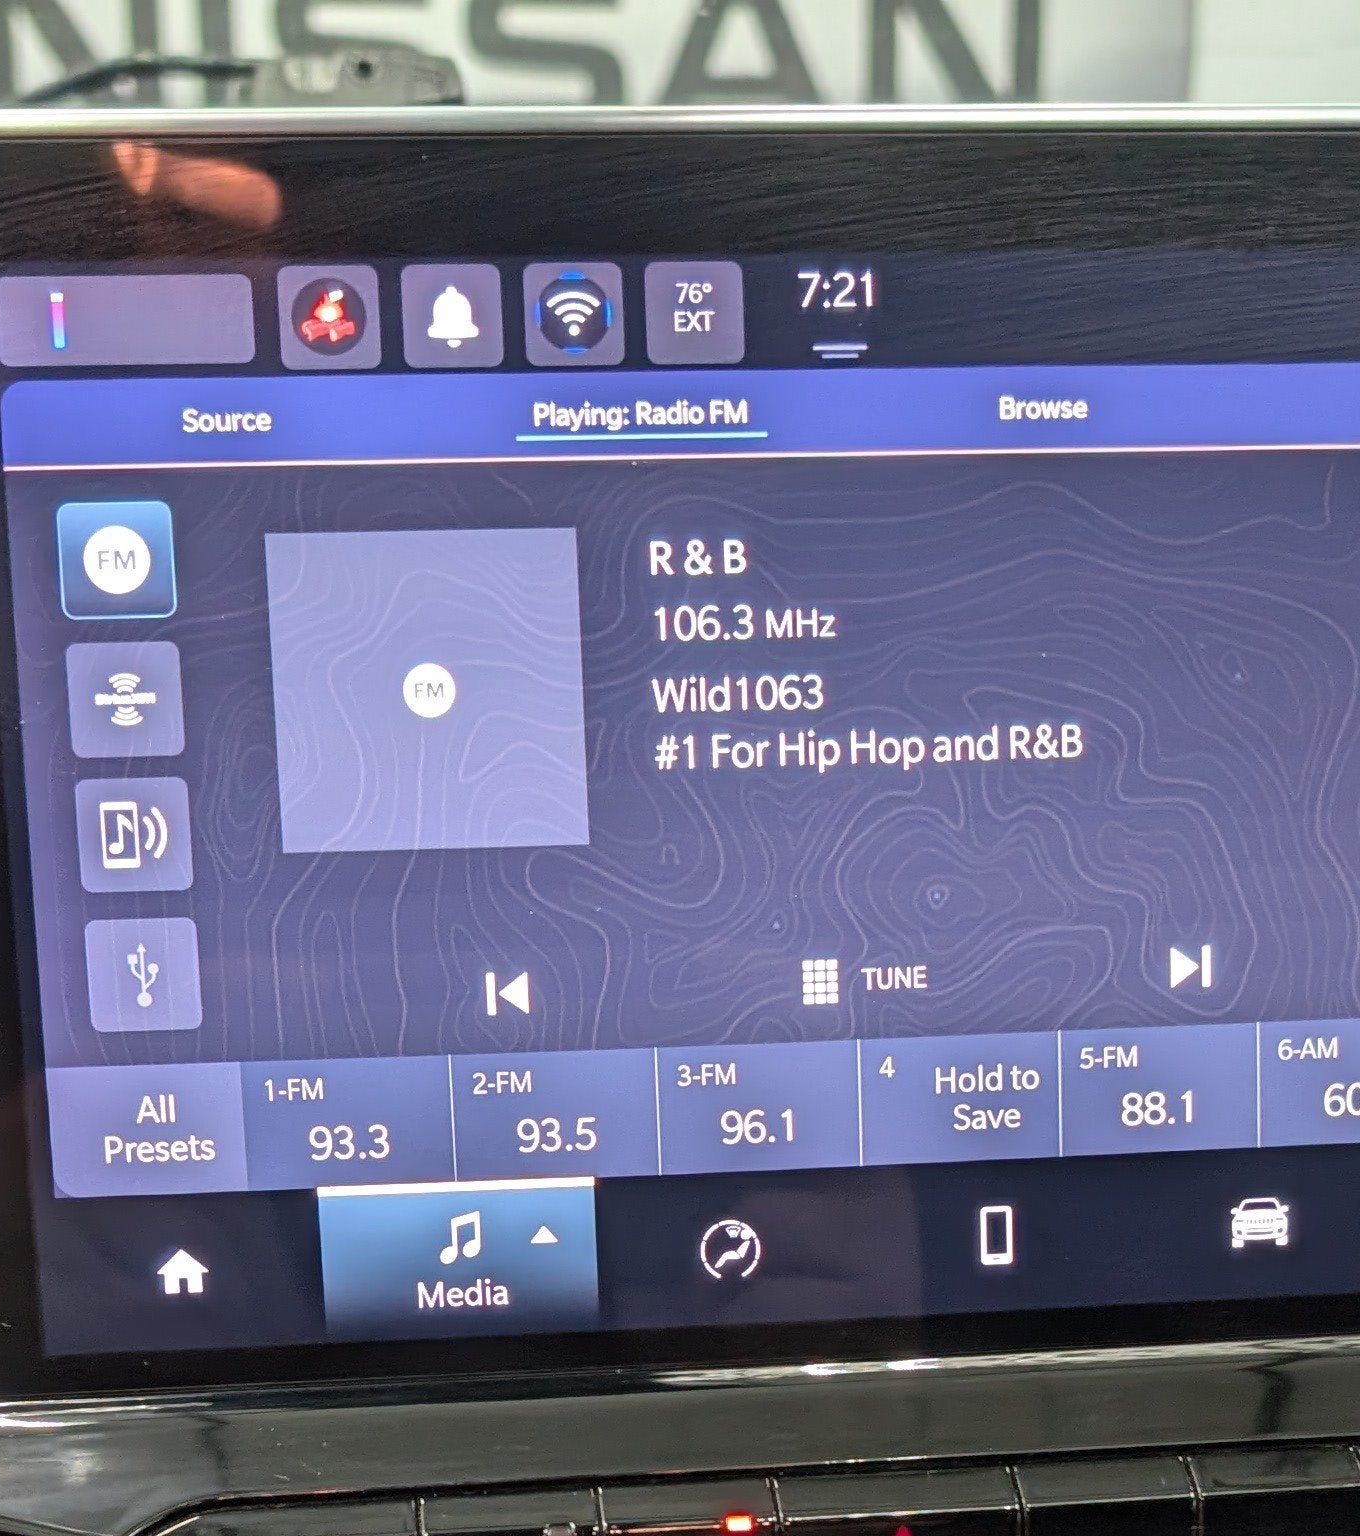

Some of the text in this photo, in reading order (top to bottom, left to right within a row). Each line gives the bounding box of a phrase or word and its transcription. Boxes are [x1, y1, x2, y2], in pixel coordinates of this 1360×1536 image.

[797, 268, 873, 309] 7:21
[673, 310, 716, 333] EXT
[182, 407, 272, 433] Source
[532, 398, 748, 432] Playing: Radio FM
[998, 394, 1089, 421] Browse
[97, 549, 136, 570] FM
[649, 538, 747, 576] R & B
[654, 603, 837, 642] 106.3 MHz
[414, 682, 444, 699] FM
[651, 673, 824, 714] Wild1063
[654, 723, 1083, 774] #1 For Hip Hop and R&B
[860, 965, 928, 991] TUNE
[1079, 1044, 1138, 1070] 5-FM
[1277, 1036, 1338, 1061] 6-AM
[677, 1062, 737, 1087] 3-FM
[878, 1056, 896, 1078] 4
[935, 1063, 1040, 1095] Hold to
[264, 1077, 324, 1102] 1-FM
[472, 1070, 532, 1095] 2-FM
[136, 1093, 176, 1124] All
[953, 1103, 1022, 1131] Save
[1121, 1089, 1193, 1127] 88.1
[516, 1116, 597, 1153] 93.5
[720, 1108, 794, 1145] 96.1
[104, 1134, 216, 1164] Presets
[308, 1123, 390, 1161] 93.3
[417, 1278, 510, 1309] Media
